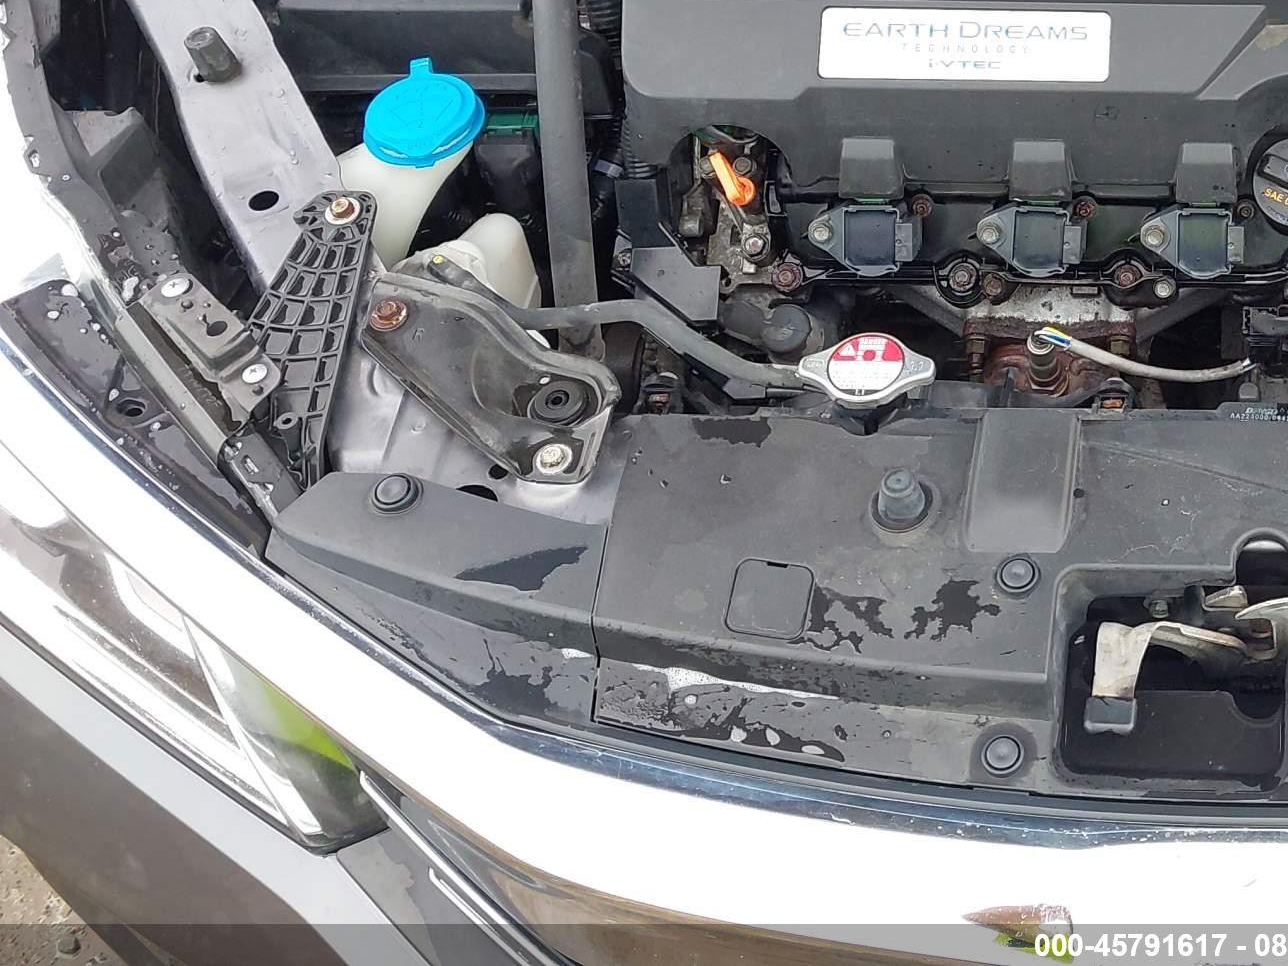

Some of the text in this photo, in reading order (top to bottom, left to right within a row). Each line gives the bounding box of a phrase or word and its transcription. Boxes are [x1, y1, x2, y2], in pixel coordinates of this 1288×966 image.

[843, 21, 1088, 41] EARTH DREAMS
[902, 42, 1030, 54] TECHNOLOGY
[1264, 188, 1285, 203] SAE
